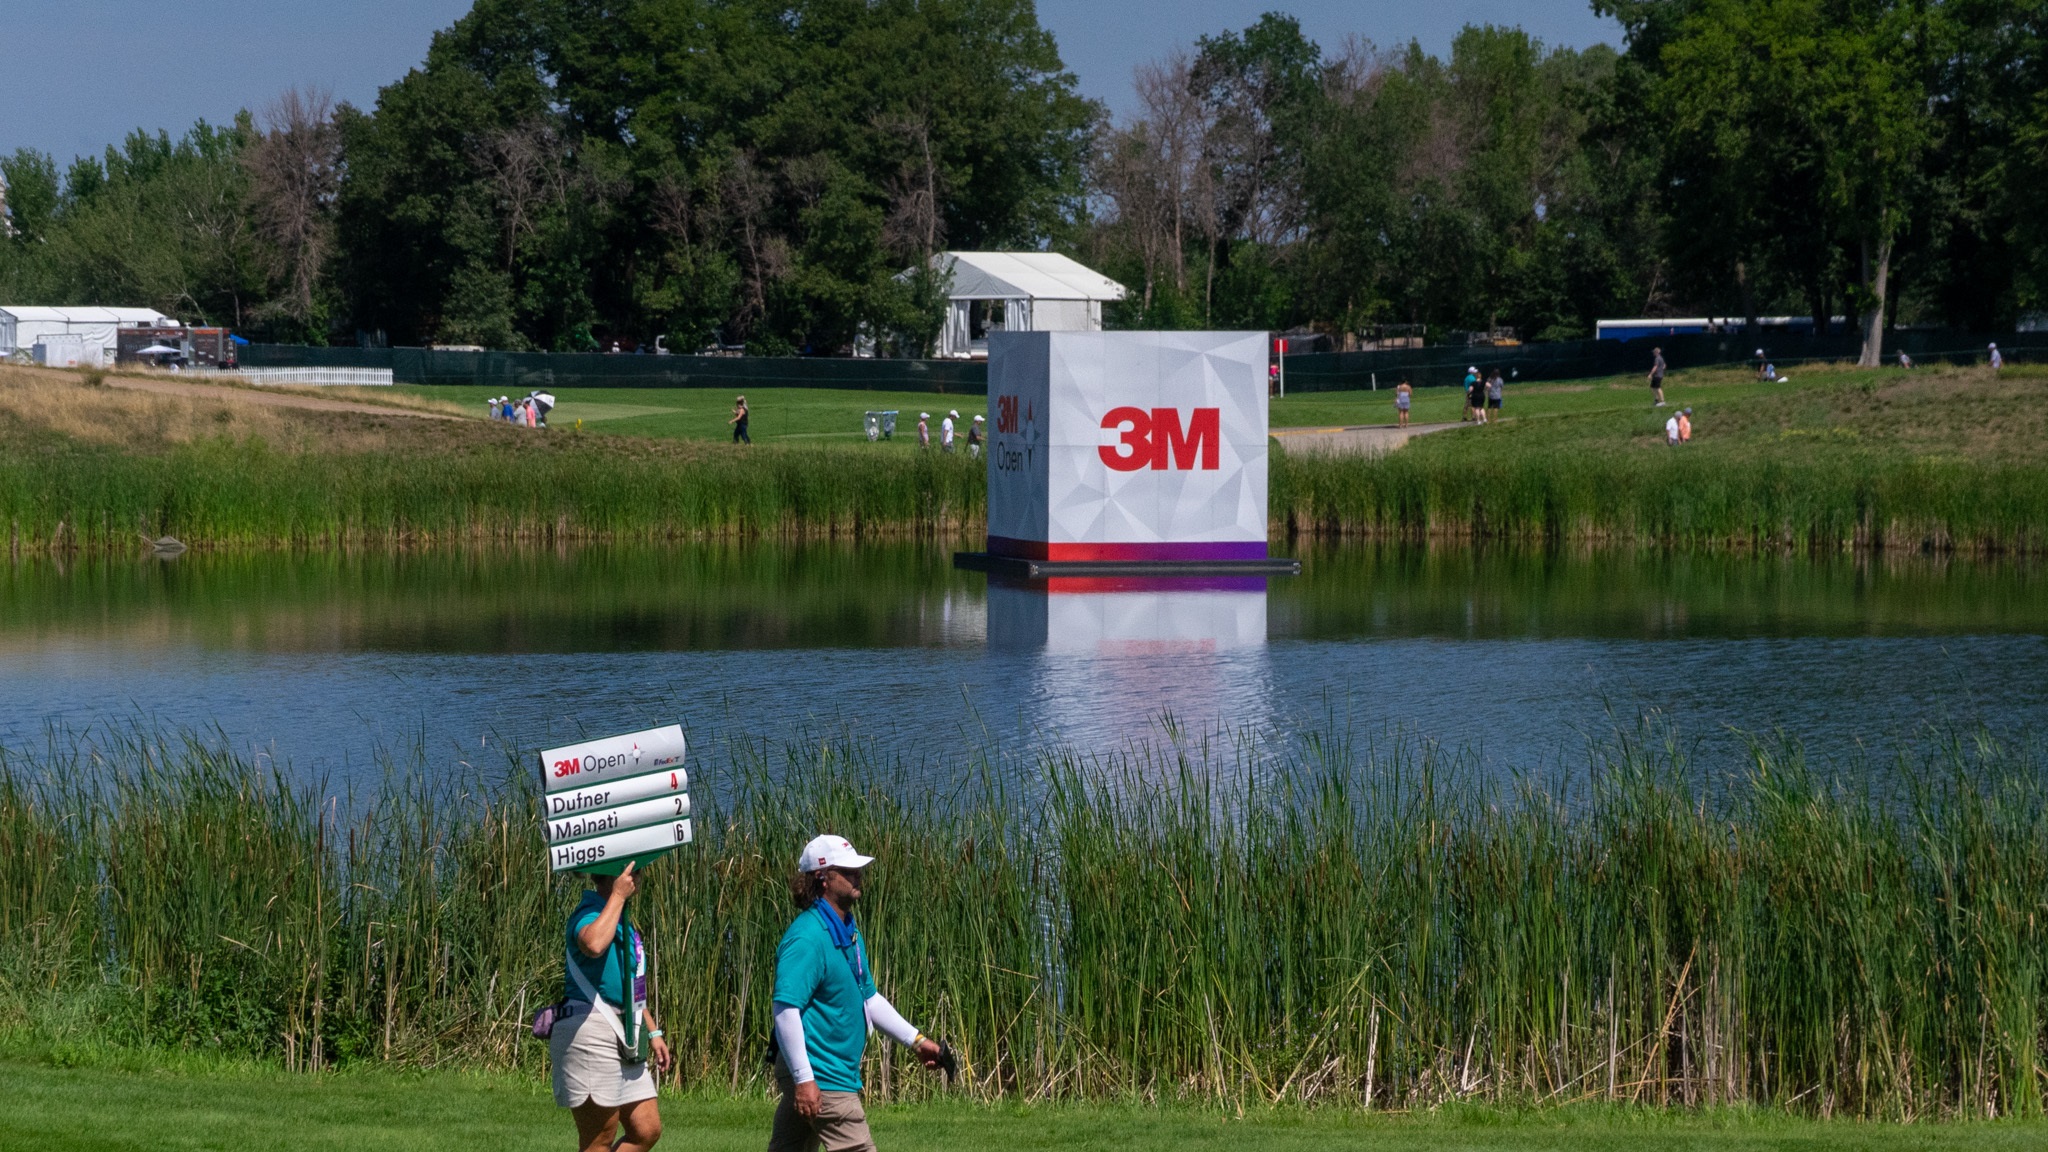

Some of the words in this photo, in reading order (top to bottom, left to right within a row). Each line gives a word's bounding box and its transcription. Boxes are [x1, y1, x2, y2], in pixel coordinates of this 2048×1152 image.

[997, 395, 1018, 433] 3M
[997, 441, 1023, 477] Open
[1098, 406, 1220, 472] 3M
[554, 757, 580, 778] 3M
[583, 753, 626, 773] Open
[552, 791, 611, 814] Dufner
[670, 772, 679, 790] 4
[555, 811, 618, 840] Malnati
[674, 798, 683, 815] 2
[557, 844, 606, 866] Higgs
[676, 823, 684, 842] 6
